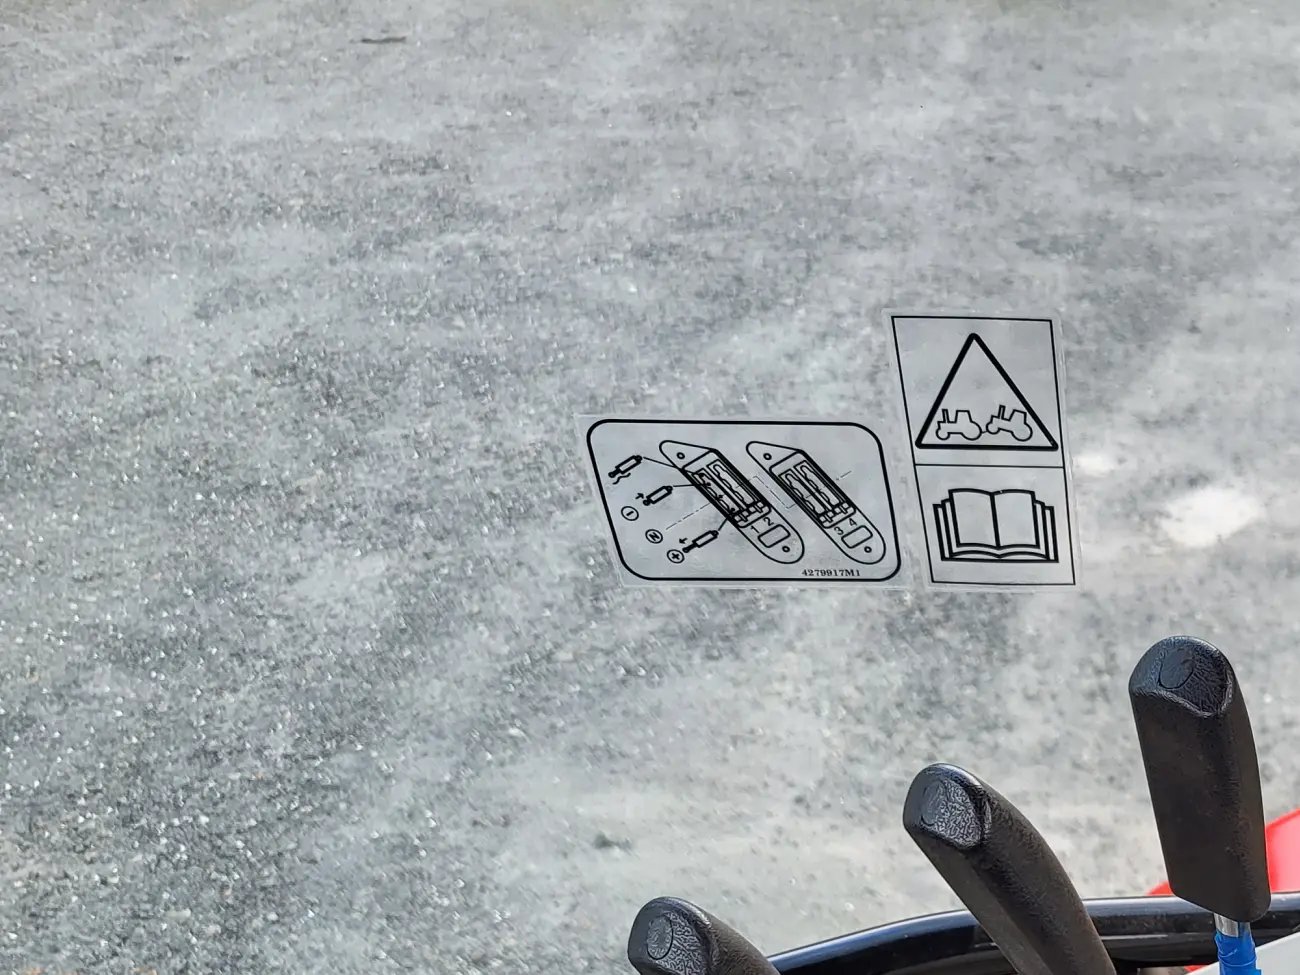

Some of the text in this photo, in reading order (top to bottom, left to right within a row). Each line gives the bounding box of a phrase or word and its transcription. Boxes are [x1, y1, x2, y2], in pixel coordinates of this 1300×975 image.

[750, 516, 774, 534] 1 2
[833, 517, 858, 535] 3 4
[801, 568, 861, 577] 4279917M1
